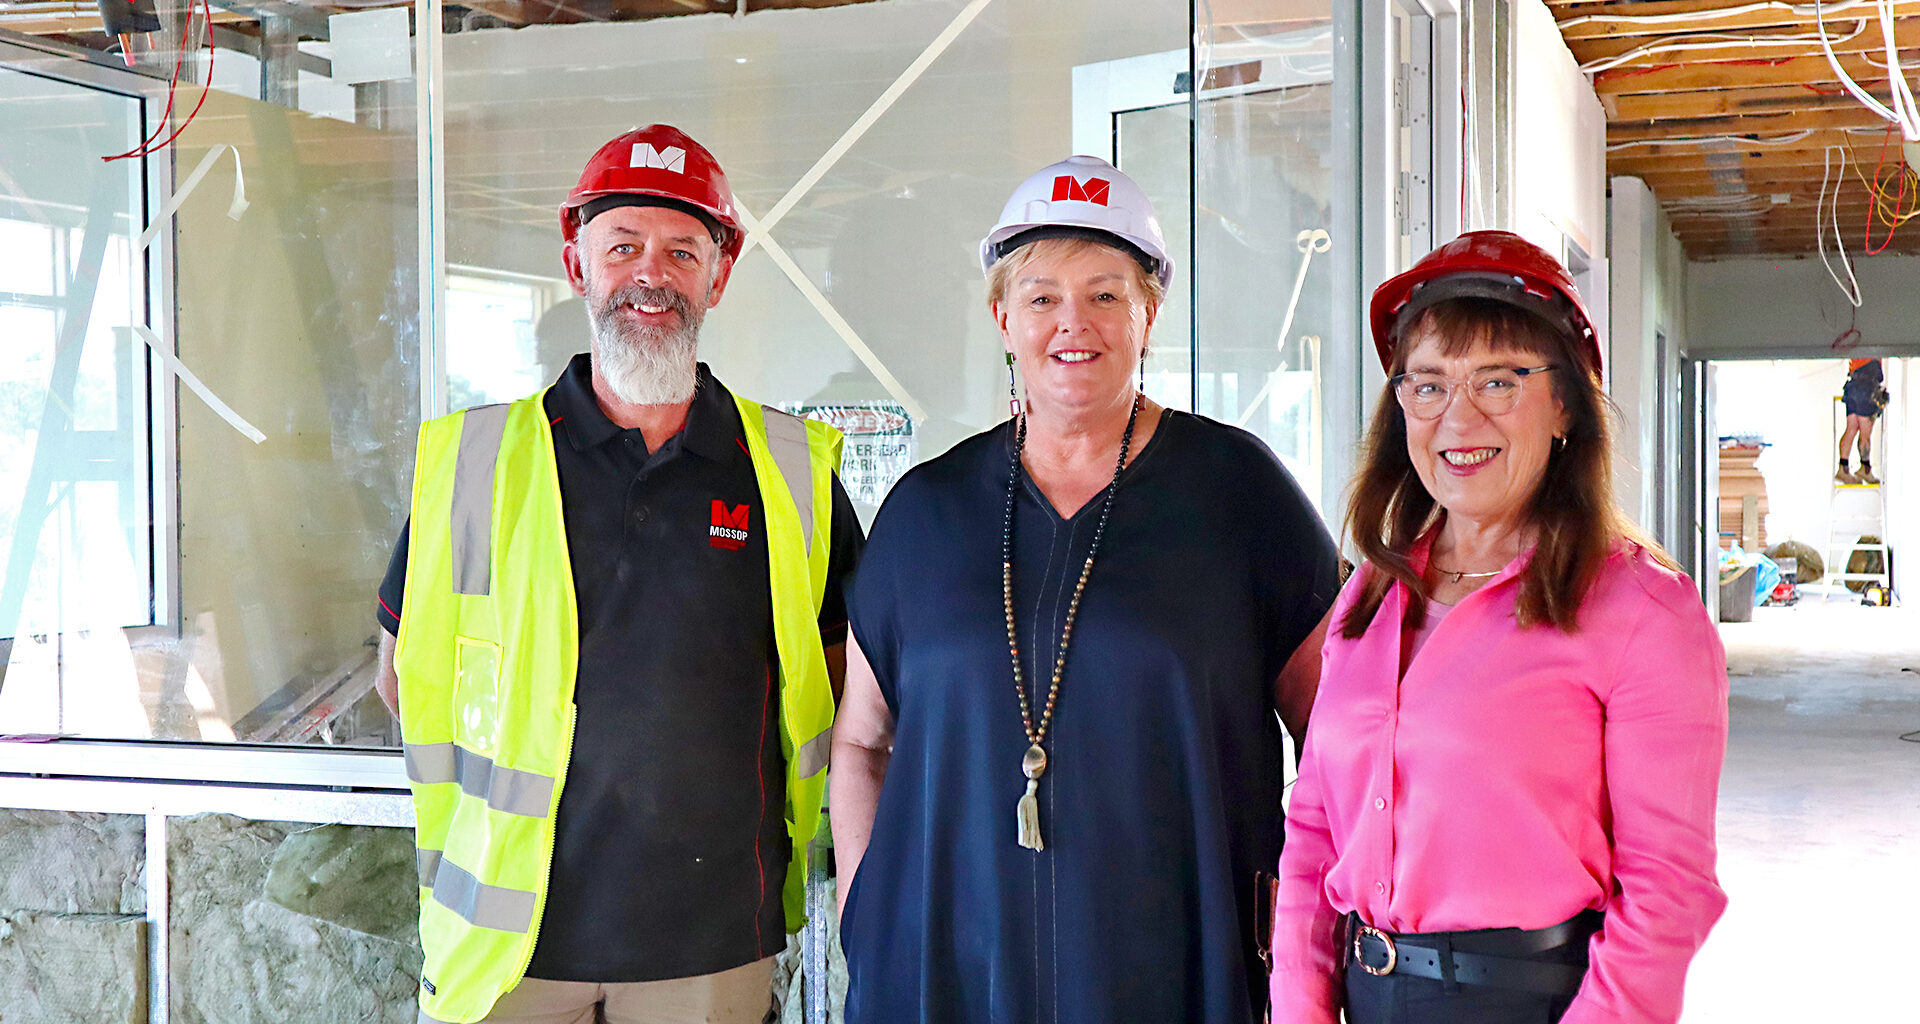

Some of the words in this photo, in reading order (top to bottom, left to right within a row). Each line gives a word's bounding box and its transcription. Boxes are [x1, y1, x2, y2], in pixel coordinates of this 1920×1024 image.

[629, 142, 686, 175] M
[1051, 175, 1111, 207] M
[710, 525, 748, 541] MOSSOP
